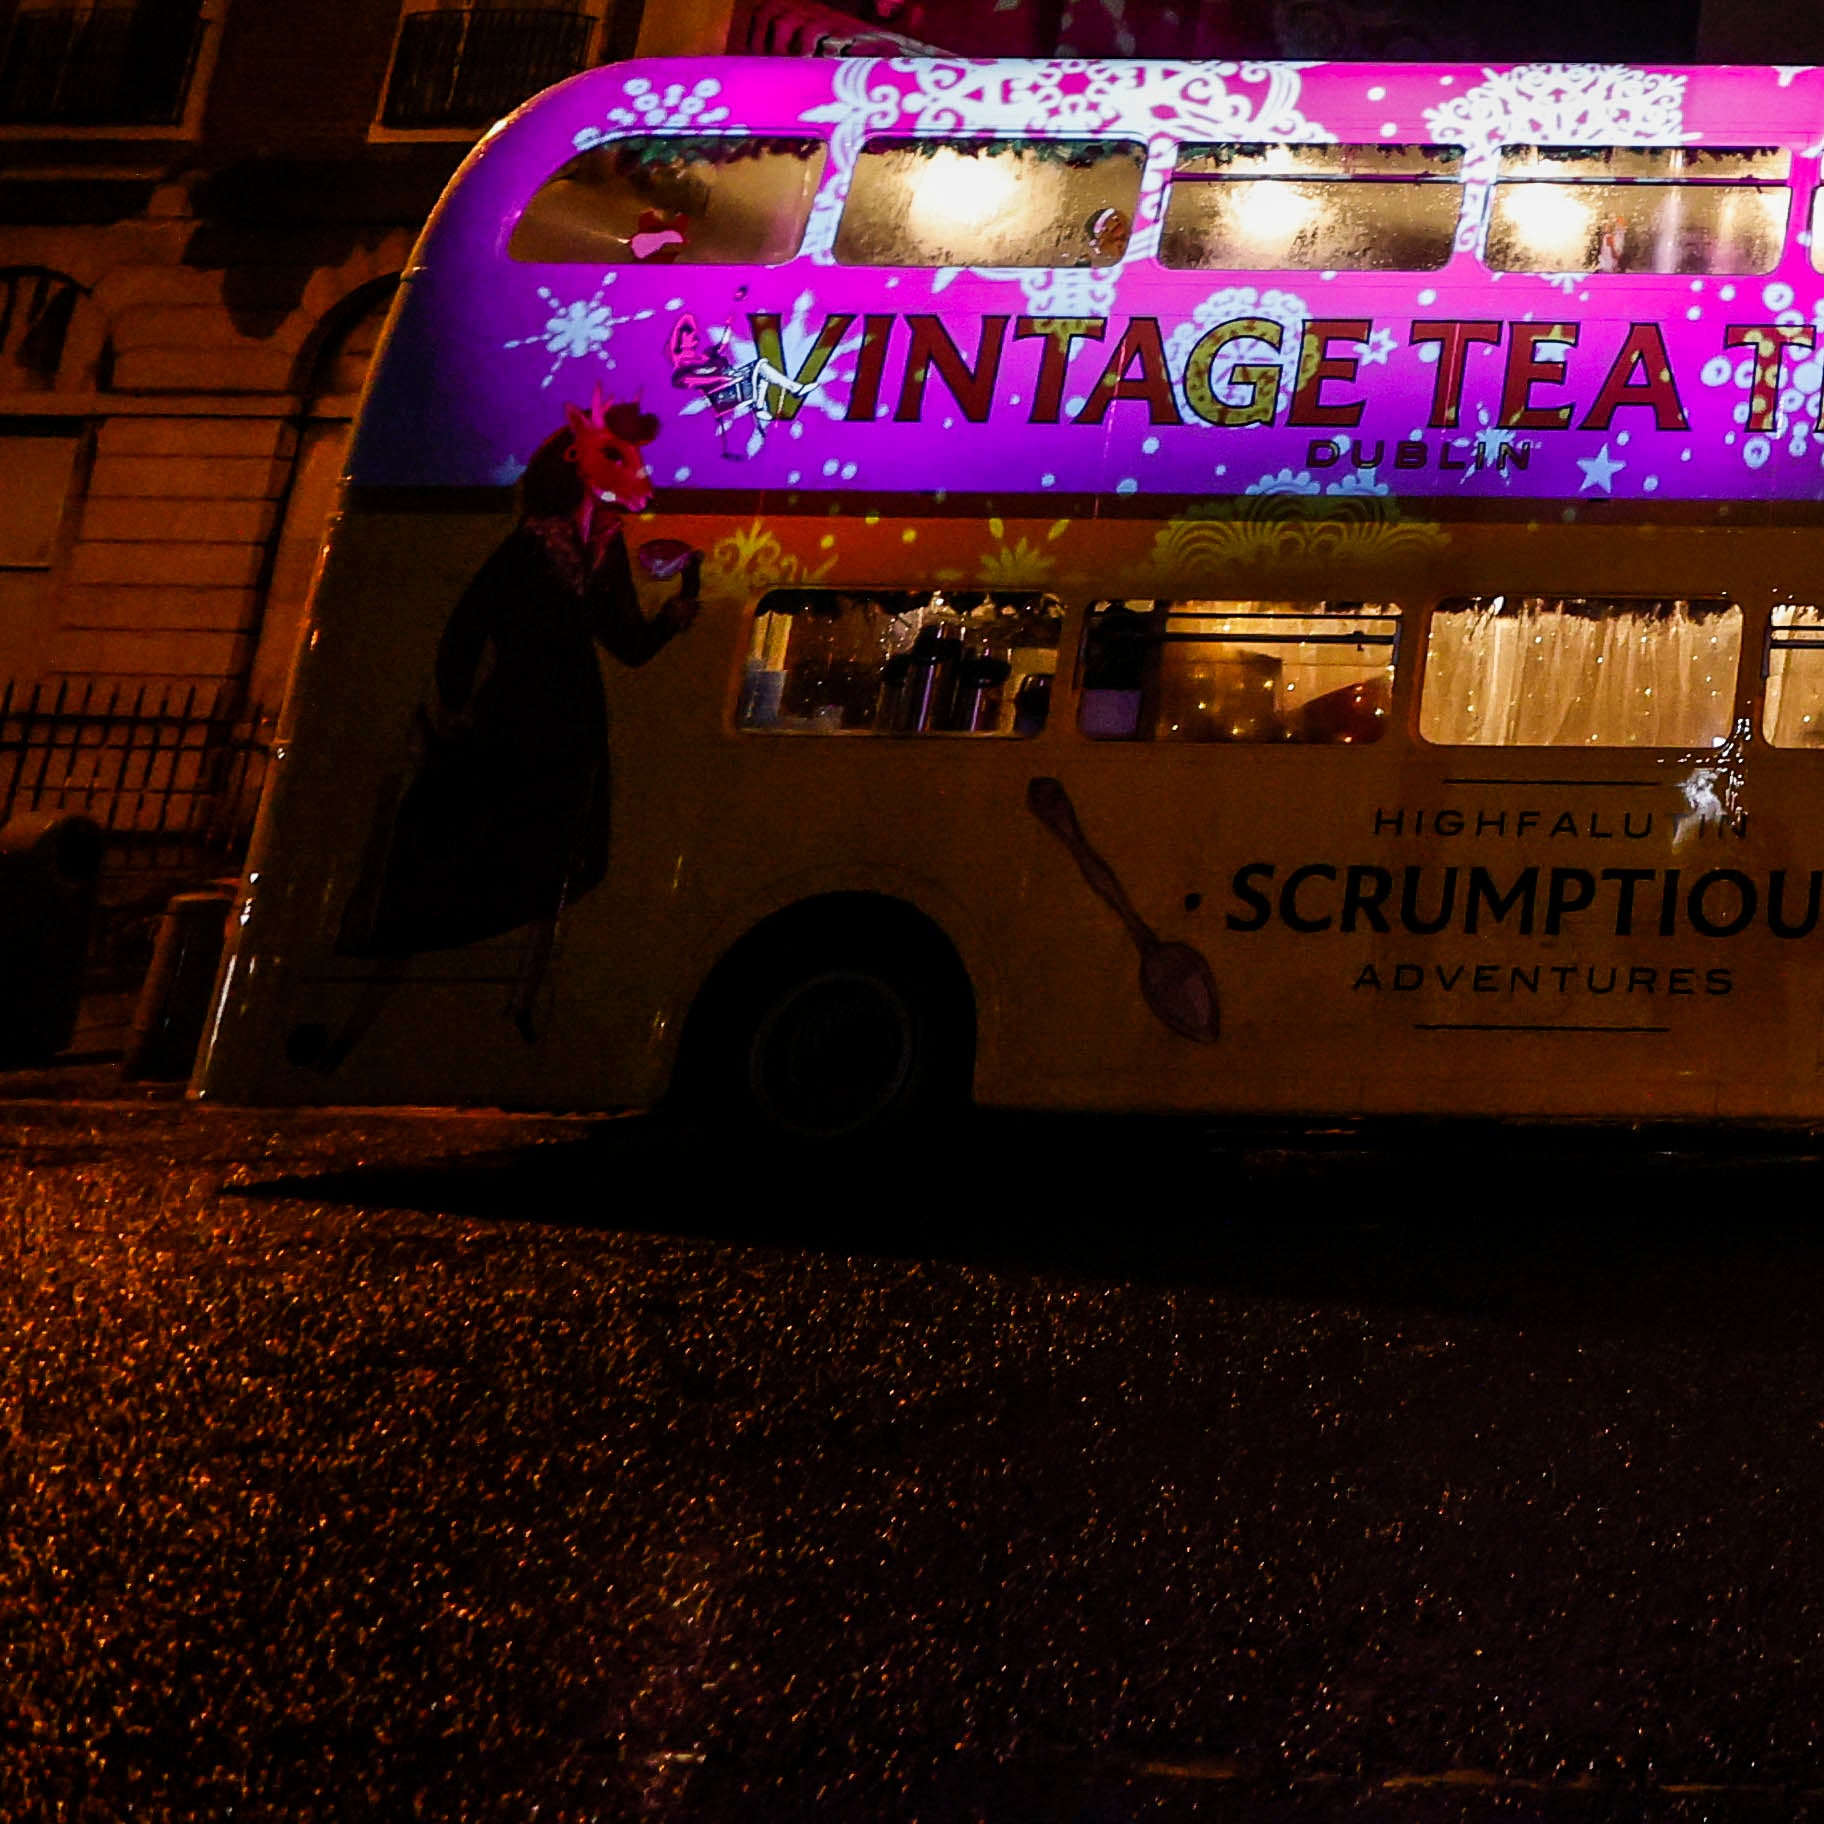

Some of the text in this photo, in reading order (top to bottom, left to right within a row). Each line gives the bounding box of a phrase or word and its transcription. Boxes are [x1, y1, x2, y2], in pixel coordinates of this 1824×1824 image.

[748, 313, 1374, 428] VINTAGE
[1410, 320, 1692, 432] TEA
[1304, 440, 1534, 471] DUBLIN
[1351, 962, 1735, 996] ADVENTURES
